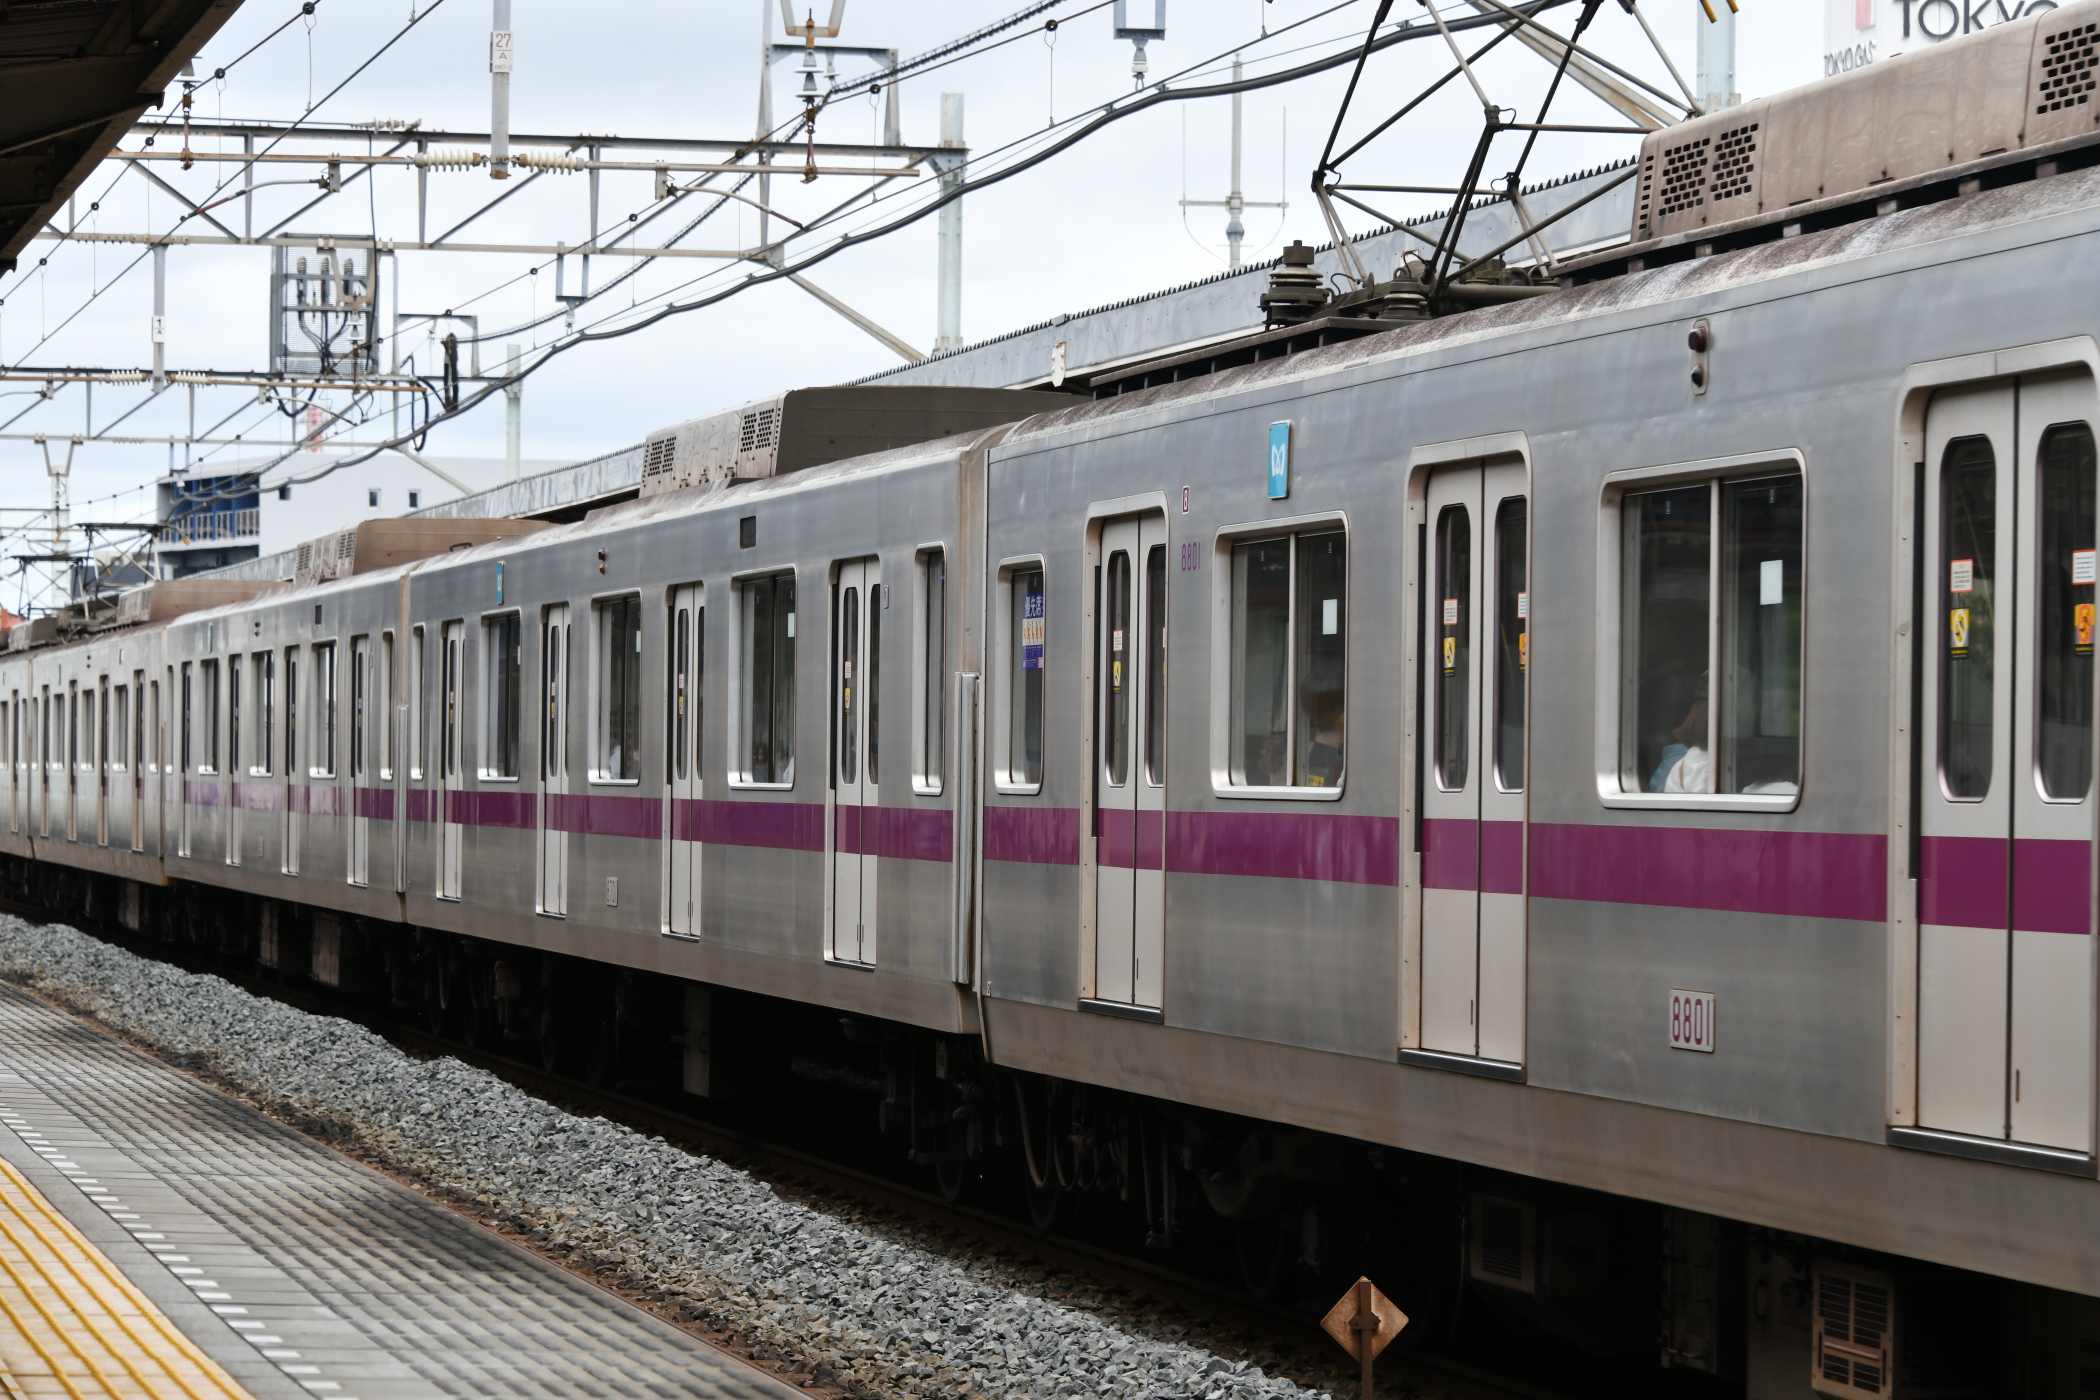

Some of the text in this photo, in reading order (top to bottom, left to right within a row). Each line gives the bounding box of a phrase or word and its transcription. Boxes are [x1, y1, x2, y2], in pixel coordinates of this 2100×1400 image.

[495, 33, 511, 48] 27
[499, 52, 507, 60] A
[1824, 40, 1876, 77] TOKYO GAS
[156, 318, 162, 328] 1
[1181, 541, 1201, 572] 8801
[1672, 995, 1710, 1047] 8801
